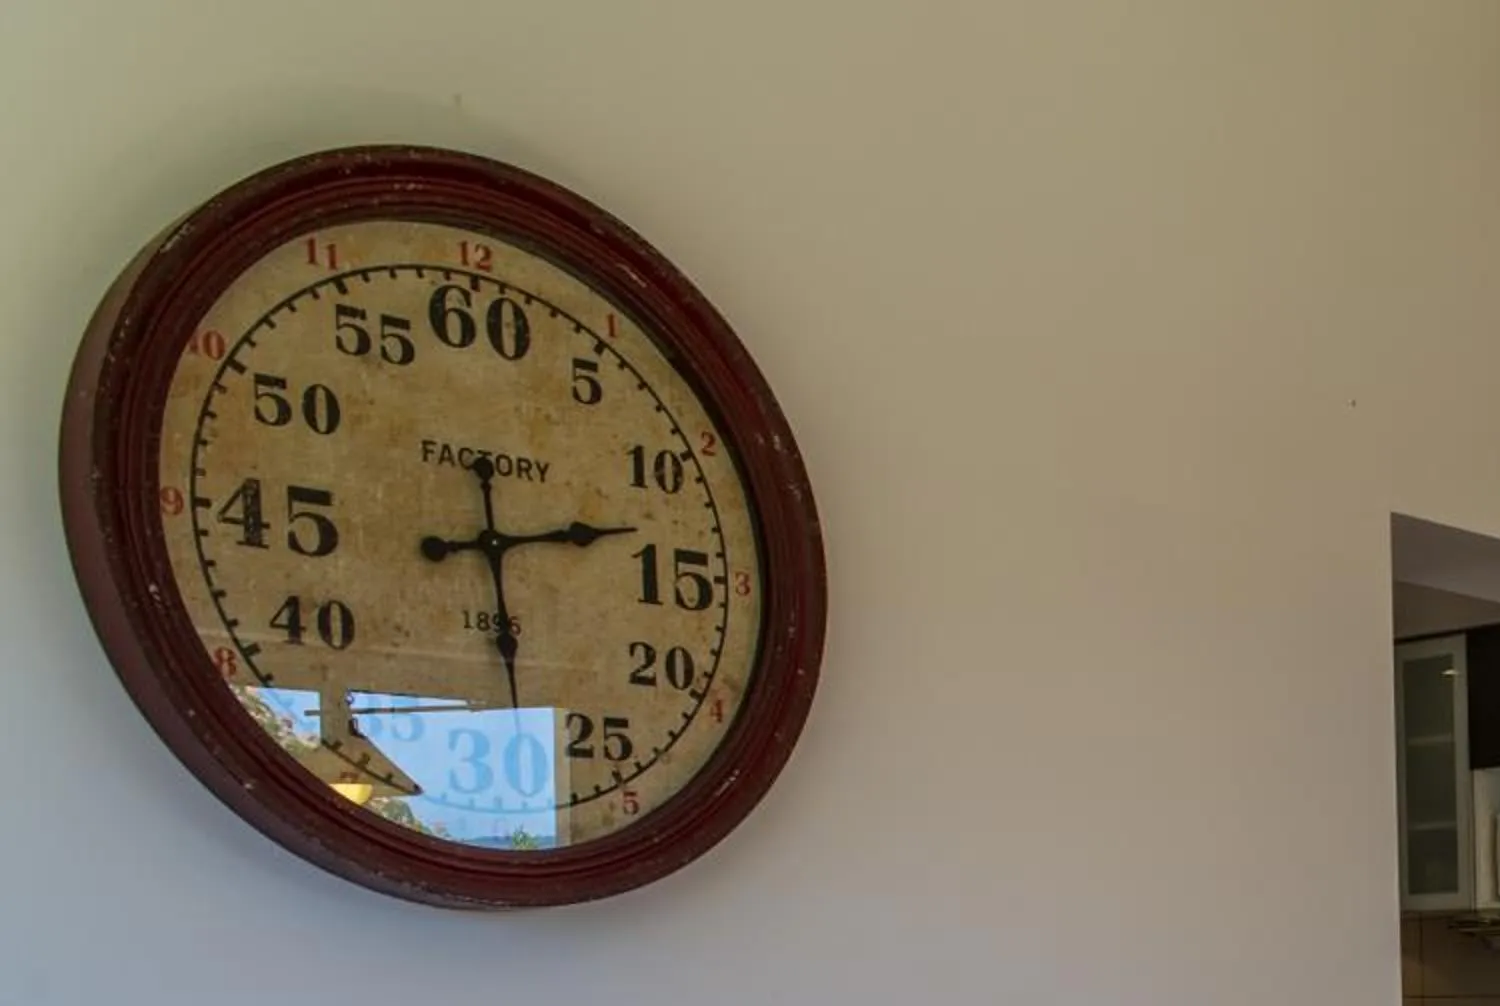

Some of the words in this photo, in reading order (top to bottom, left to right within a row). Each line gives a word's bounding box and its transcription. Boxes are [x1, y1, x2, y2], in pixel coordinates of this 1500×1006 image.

[306, 236, 338, 270] 11
[457, 240, 494, 272] 12
[335, 304, 415, 365] 55
[429, 285, 531, 361] 60
[606, 312, 619, 339] 1
[254, 373, 341, 435] 50
[572, 358, 603, 405] 5
[700, 431, 717, 457] 2
[627, 445, 684, 494] 10
[161, 486, 185, 516] 9
[217, 477, 339, 557] 45
[632, 543, 714, 611] 15
[734, 571, 751, 597] 3
[269, 595, 356, 650] 40
[628, 641, 695, 691] 20
[709, 698, 724, 724] 4
[565, 712, 634, 762] 25
[447, 727, 549, 797] 30
[623, 791, 639, 816] 5
